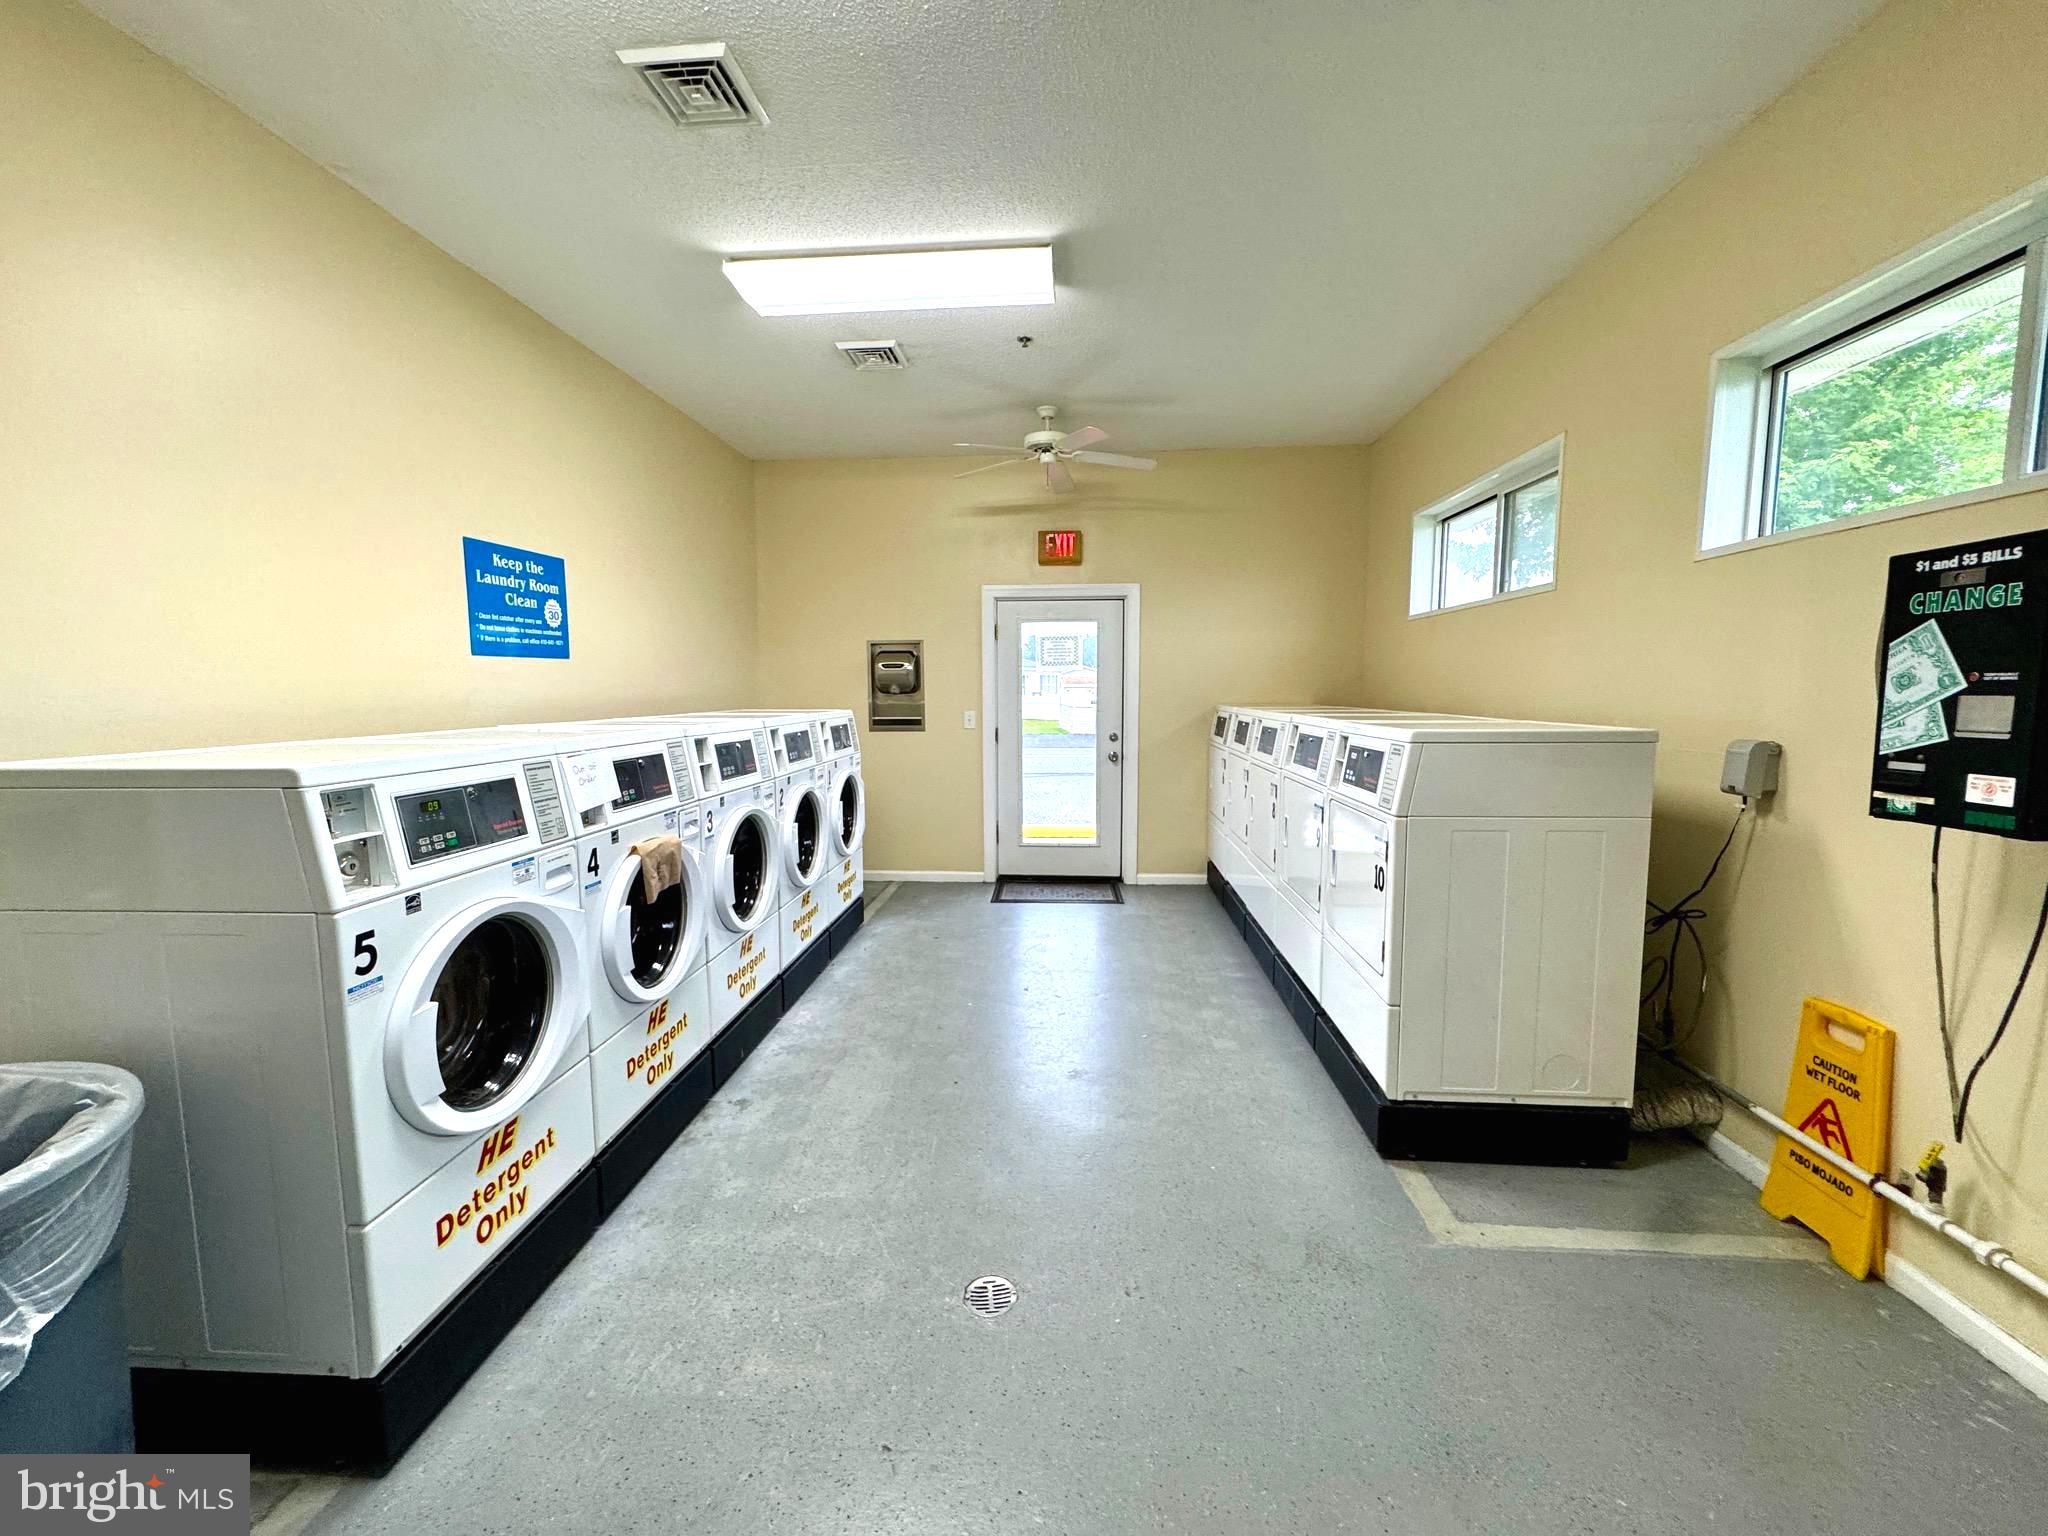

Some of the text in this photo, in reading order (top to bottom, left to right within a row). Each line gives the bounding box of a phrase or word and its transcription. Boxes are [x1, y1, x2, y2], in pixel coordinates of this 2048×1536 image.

[1045, 533, 1076, 557] EXIT
[1915, 546, 2023, 573] $1 and $5 BILLS
[492, 553, 544, 575] Keep the
[475, 569, 559, 594] Laundry Room
[505, 592, 538, 608] Clean
[1909, 581, 2024, 615] CHANGE
[548, 611, 560, 621] 30
[779, 787, 785, 807] 2
[706, 810, 714, 833] 3
[587, 847, 600, 877] 4
[1374, 864, 1385, 892] 10
[353, 929, 378, 976] 5
[739, 933, 754, 959] HE
[726, 947, 767, 990] Detergent
[738, 975, 757, 999] Only
[646, 999, 669, 1035] HE
[626, 1012, 689, 1080] Detergent
[646, 1051, 674, 1086] Only
[1806, 1064, 1862, 1102] WET FLOOR
[1812, 1055, 1858, 1084] CAUTION
[476, 1115, 520, 1175] HE
[435, 1126, 556, 1248] Detergent
[1788, 1148, 1854, 1197] PISO MOJADO
[476, 1185, 529, 1245] Only
